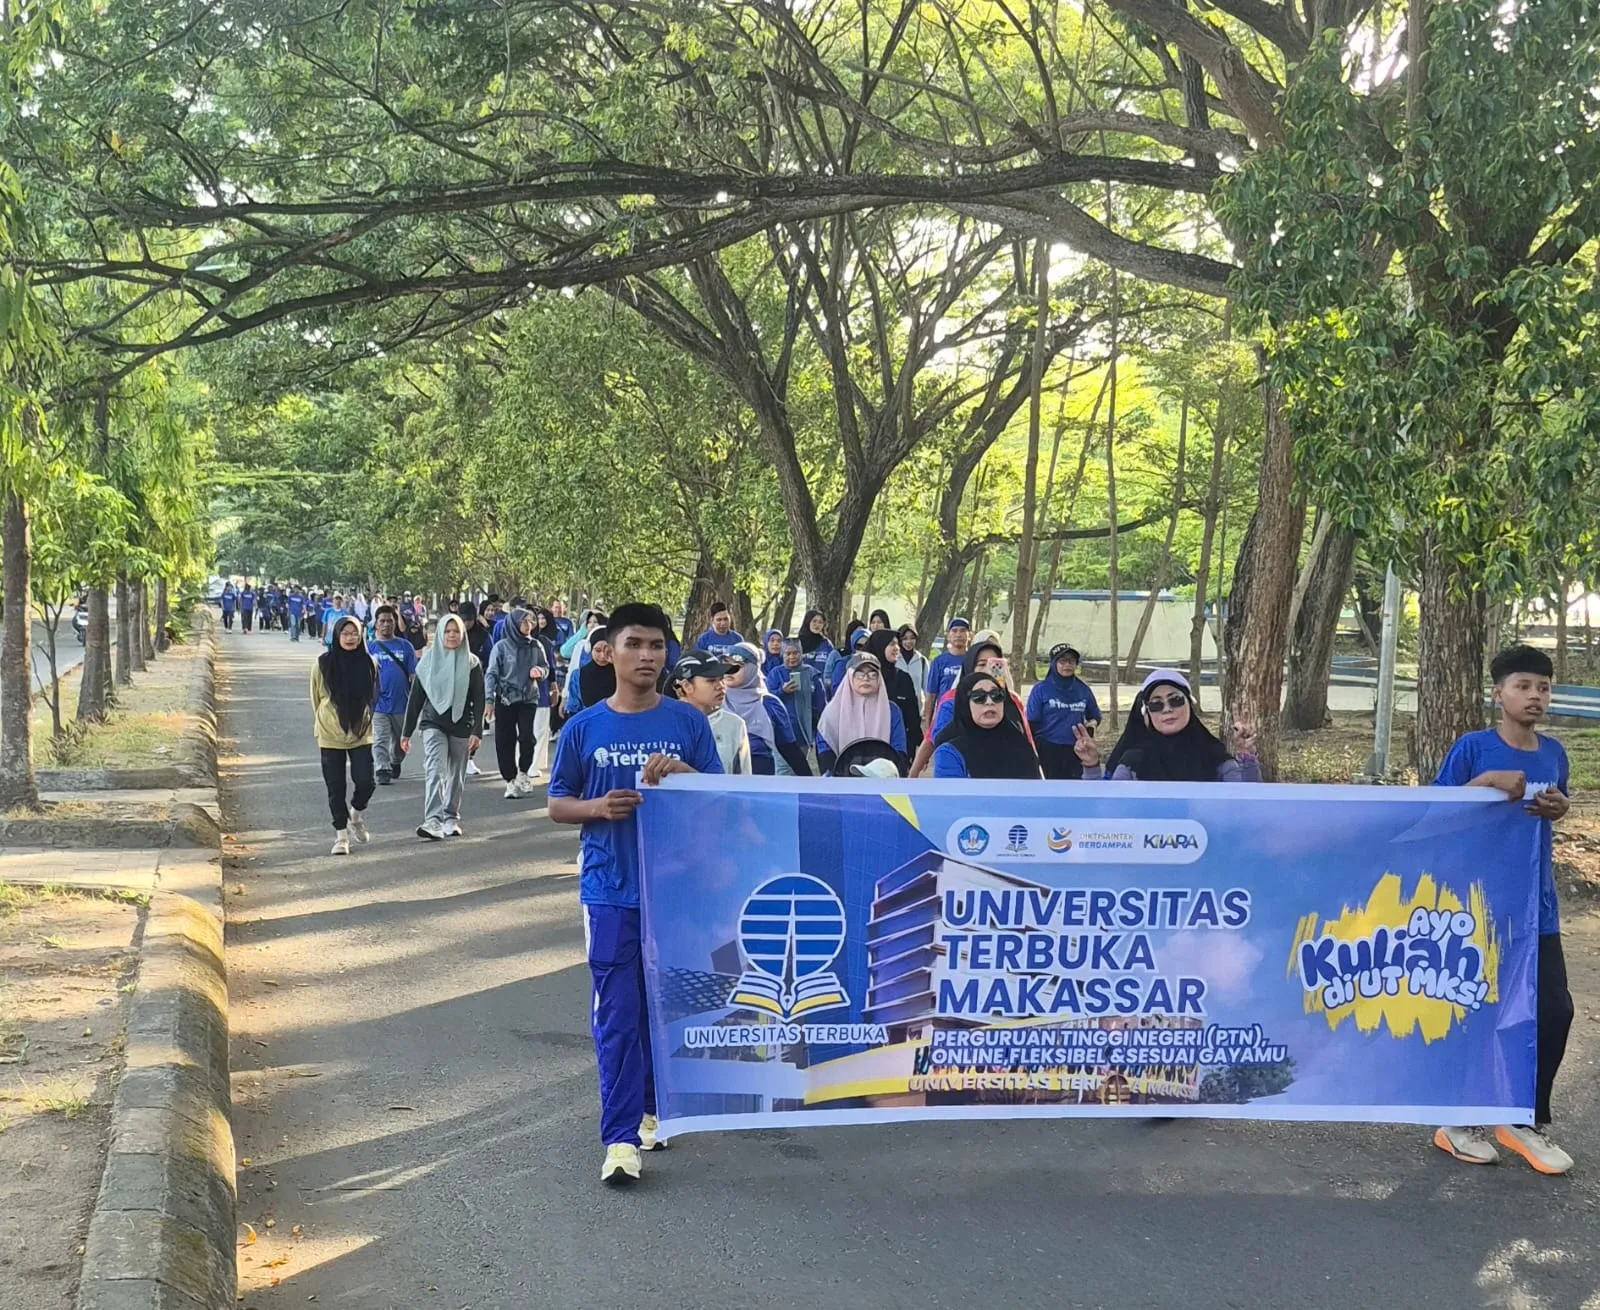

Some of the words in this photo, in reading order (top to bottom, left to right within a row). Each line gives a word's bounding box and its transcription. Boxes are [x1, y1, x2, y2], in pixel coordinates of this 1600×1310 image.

[610, 741, 681, 751] Universitas
[609, 749, 681, 767] Terbka
[1079, 841, 1133, 849] BERDAMPAK
[944, 889, 1249, 927] UNIVERSITAS
[941, 934, 1155, 970] TERBUKA
[1300, 926, 1482, 989] Kuliah
[938, 978, 1206, 1014] MAKASSAR
[1323, 974, 1355, 1009] di
[1359, 965, 1404, 998] UT
[686, 1025, 800, 1046] UNIVERSITAS
[804, 1025, 887, 1042] TERBUKA
[933, 1030, 1056, 1046] PERGURUAN
[1061, 1030, 1129, 1046] TINGGI
[1133, 1030, 1201, 1046] NEGERI
[1207, 1025, 1268, 1049] (PTN),
[1200, 1047, 1287, 1063] GAYAMU
[909, 1076, 1049, 1091] UNIVERSITAS
